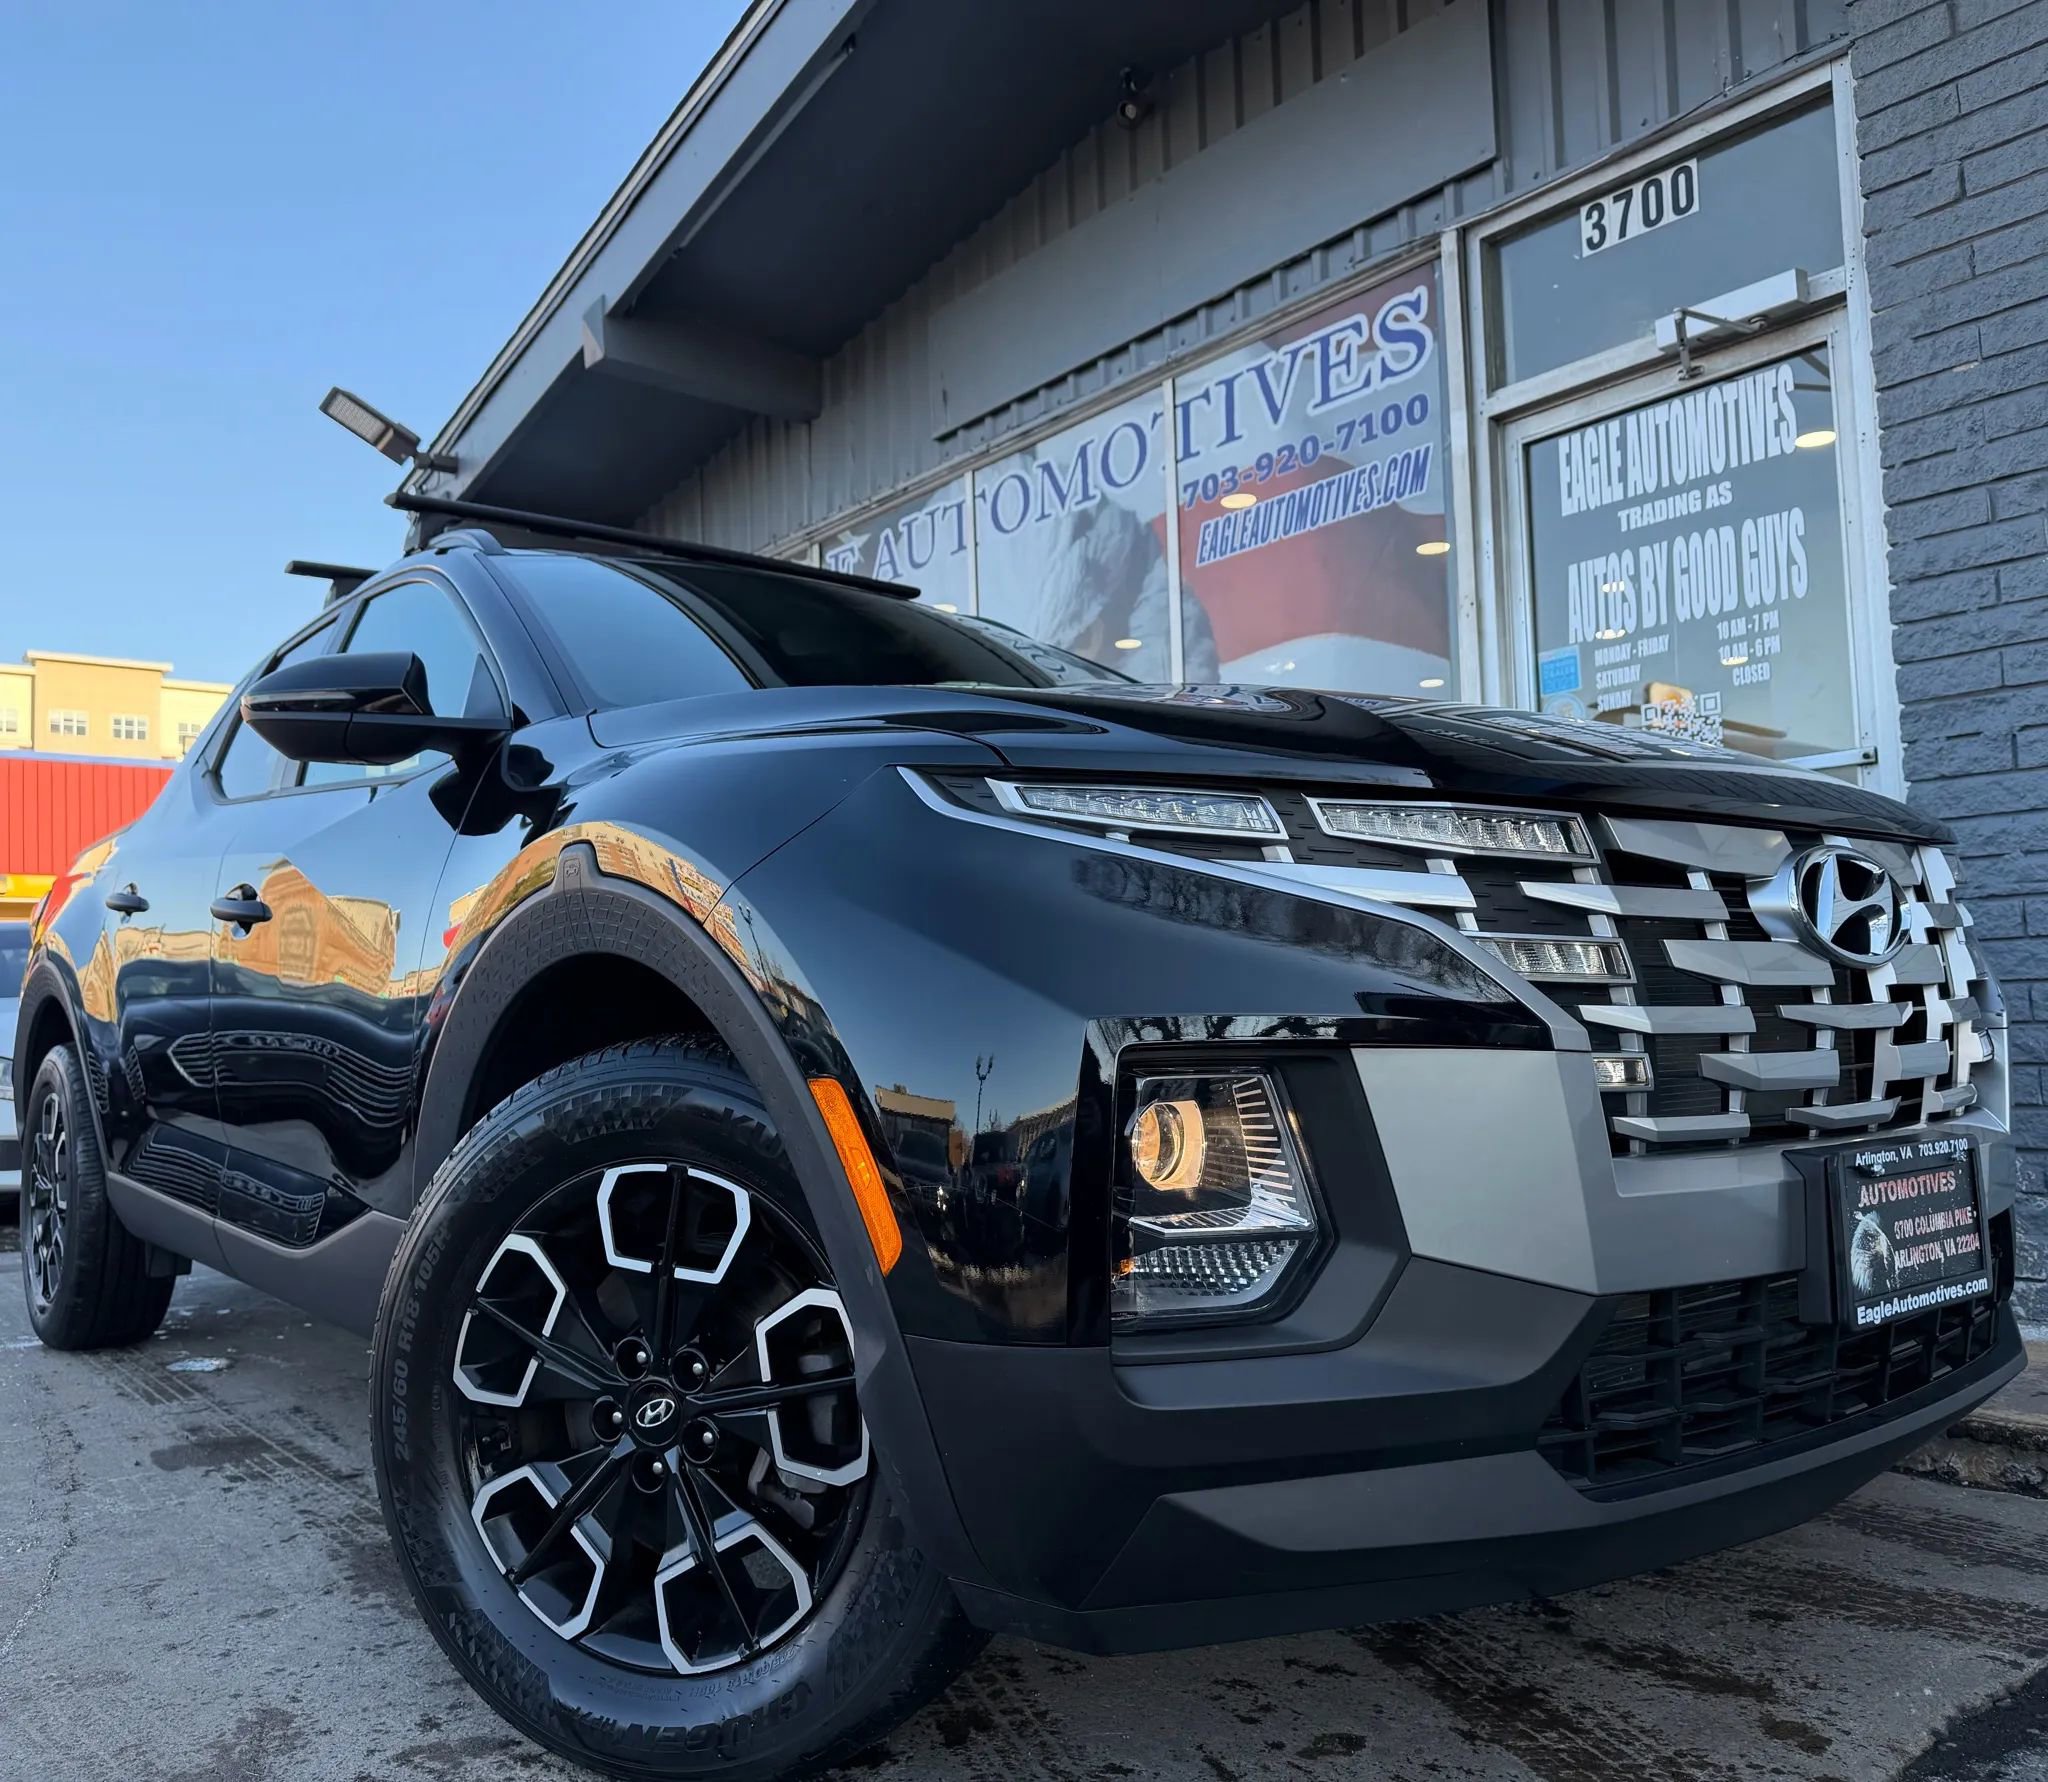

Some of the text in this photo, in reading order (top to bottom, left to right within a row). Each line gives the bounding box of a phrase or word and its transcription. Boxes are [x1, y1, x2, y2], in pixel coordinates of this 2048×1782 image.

[1585, 165, 1695, 251] 3700
[873, 287, 1432, 582] AUTOMOTIVES
[1183, 394, 1430, 509] 703-920-7100
[1558, 364, 1797, 517] EAGLE AUTOMOTIVES
[1197, 444, 1433, 567] EAGLEAUTOMOTIVES.COM
[1617, 481, 1733, 532] TRADING AS
[1568, 507, 1808, 644] AUTOS BY GOOD GUYS
[1716, 620, 1730, 640] 10
[1731, 616, 1747, 638] AM
[1762, 609, 1780, 631] PM
[1594, 642, 1632, 667] MONDAY
[1637, 634, 1669, 658] FRIDAY
[1755, 638, 1763, 657] 6
[1763, 633, 1781, 656] PM
[1595, 663, 1641, 690] SATURDAY
[1732, 661, 1771, 686] CLOSED
[1597, 688, 1632, 712] SUNDAY
[1855, 1138, 1968, 1167] Arlington, VA 703.920.7100
[1858, 1170, 1957, 1207] AUTOMOTIVES
[1914, 1210, 1955, 1235] COLUMBIA
[1954, 1206, 1973, 1227] PIKE
[1944, 1237, 1957, 1258] VA
[1956, 1231, 1981, 1254] 22204
[1857, 1278, 1988, 1325] EagleAutomotives.com
[391, 1225, 450, 1462] 245/60 R18 105H
